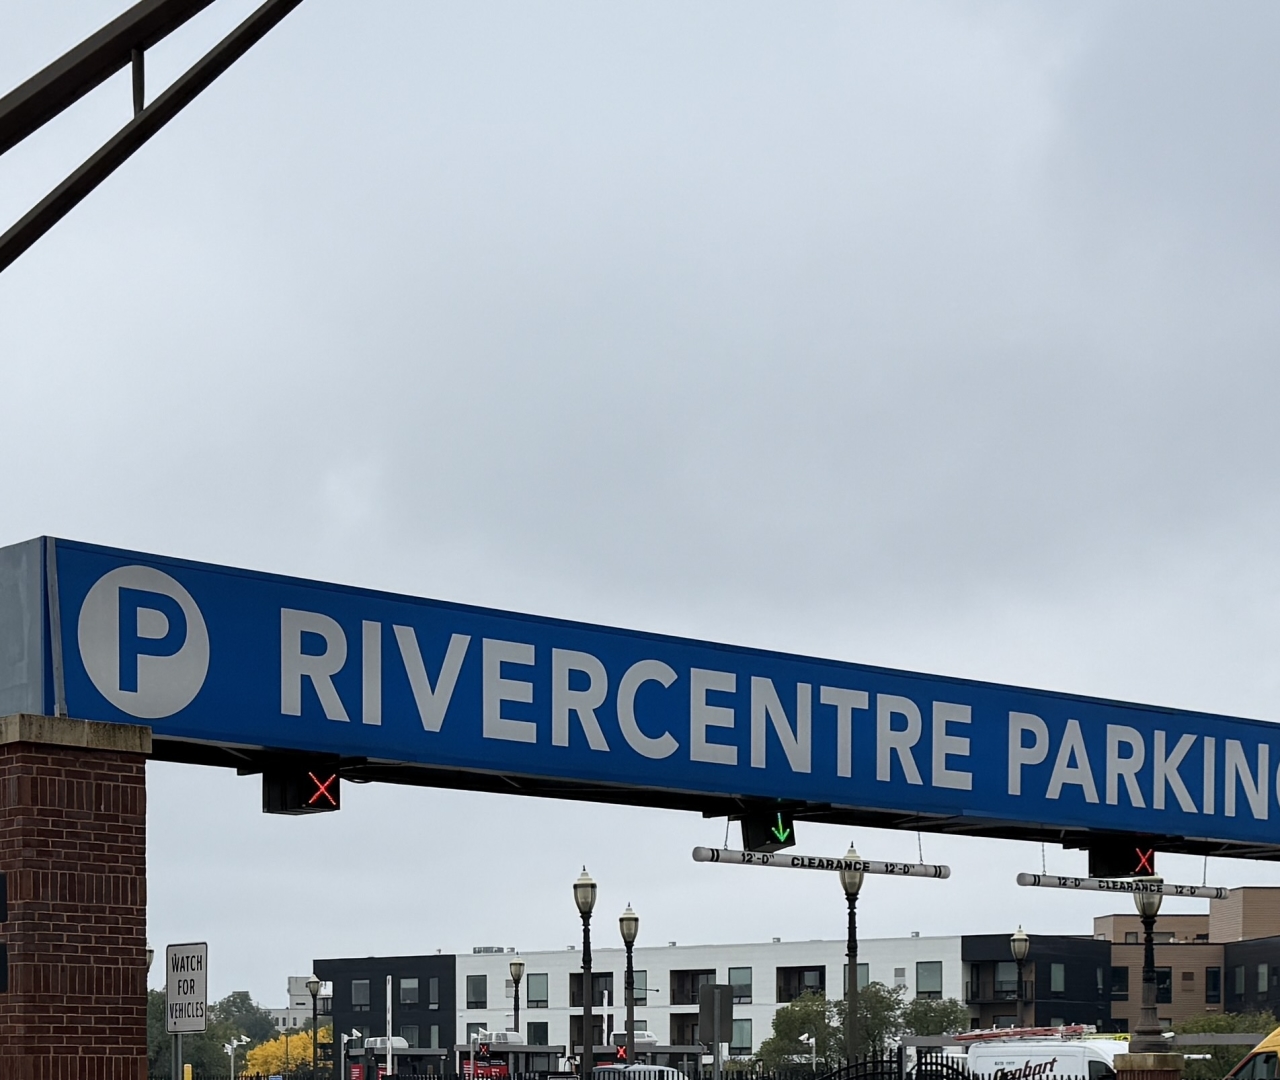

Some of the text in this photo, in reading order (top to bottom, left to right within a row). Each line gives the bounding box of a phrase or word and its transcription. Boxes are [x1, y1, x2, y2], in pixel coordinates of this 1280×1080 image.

[118, 586, 187, 694] P
[280, 607, 973, 791] RIVERCENTRE
[791, 856, 870, 872] CLEARANCE
[1098, 880, 1163, 893] CLEARANCE
[171, 953, 203, 973] WATCH
[177, 978, 195, 996] FOR
[169, 1001, 204, 1019] VEHICLES
